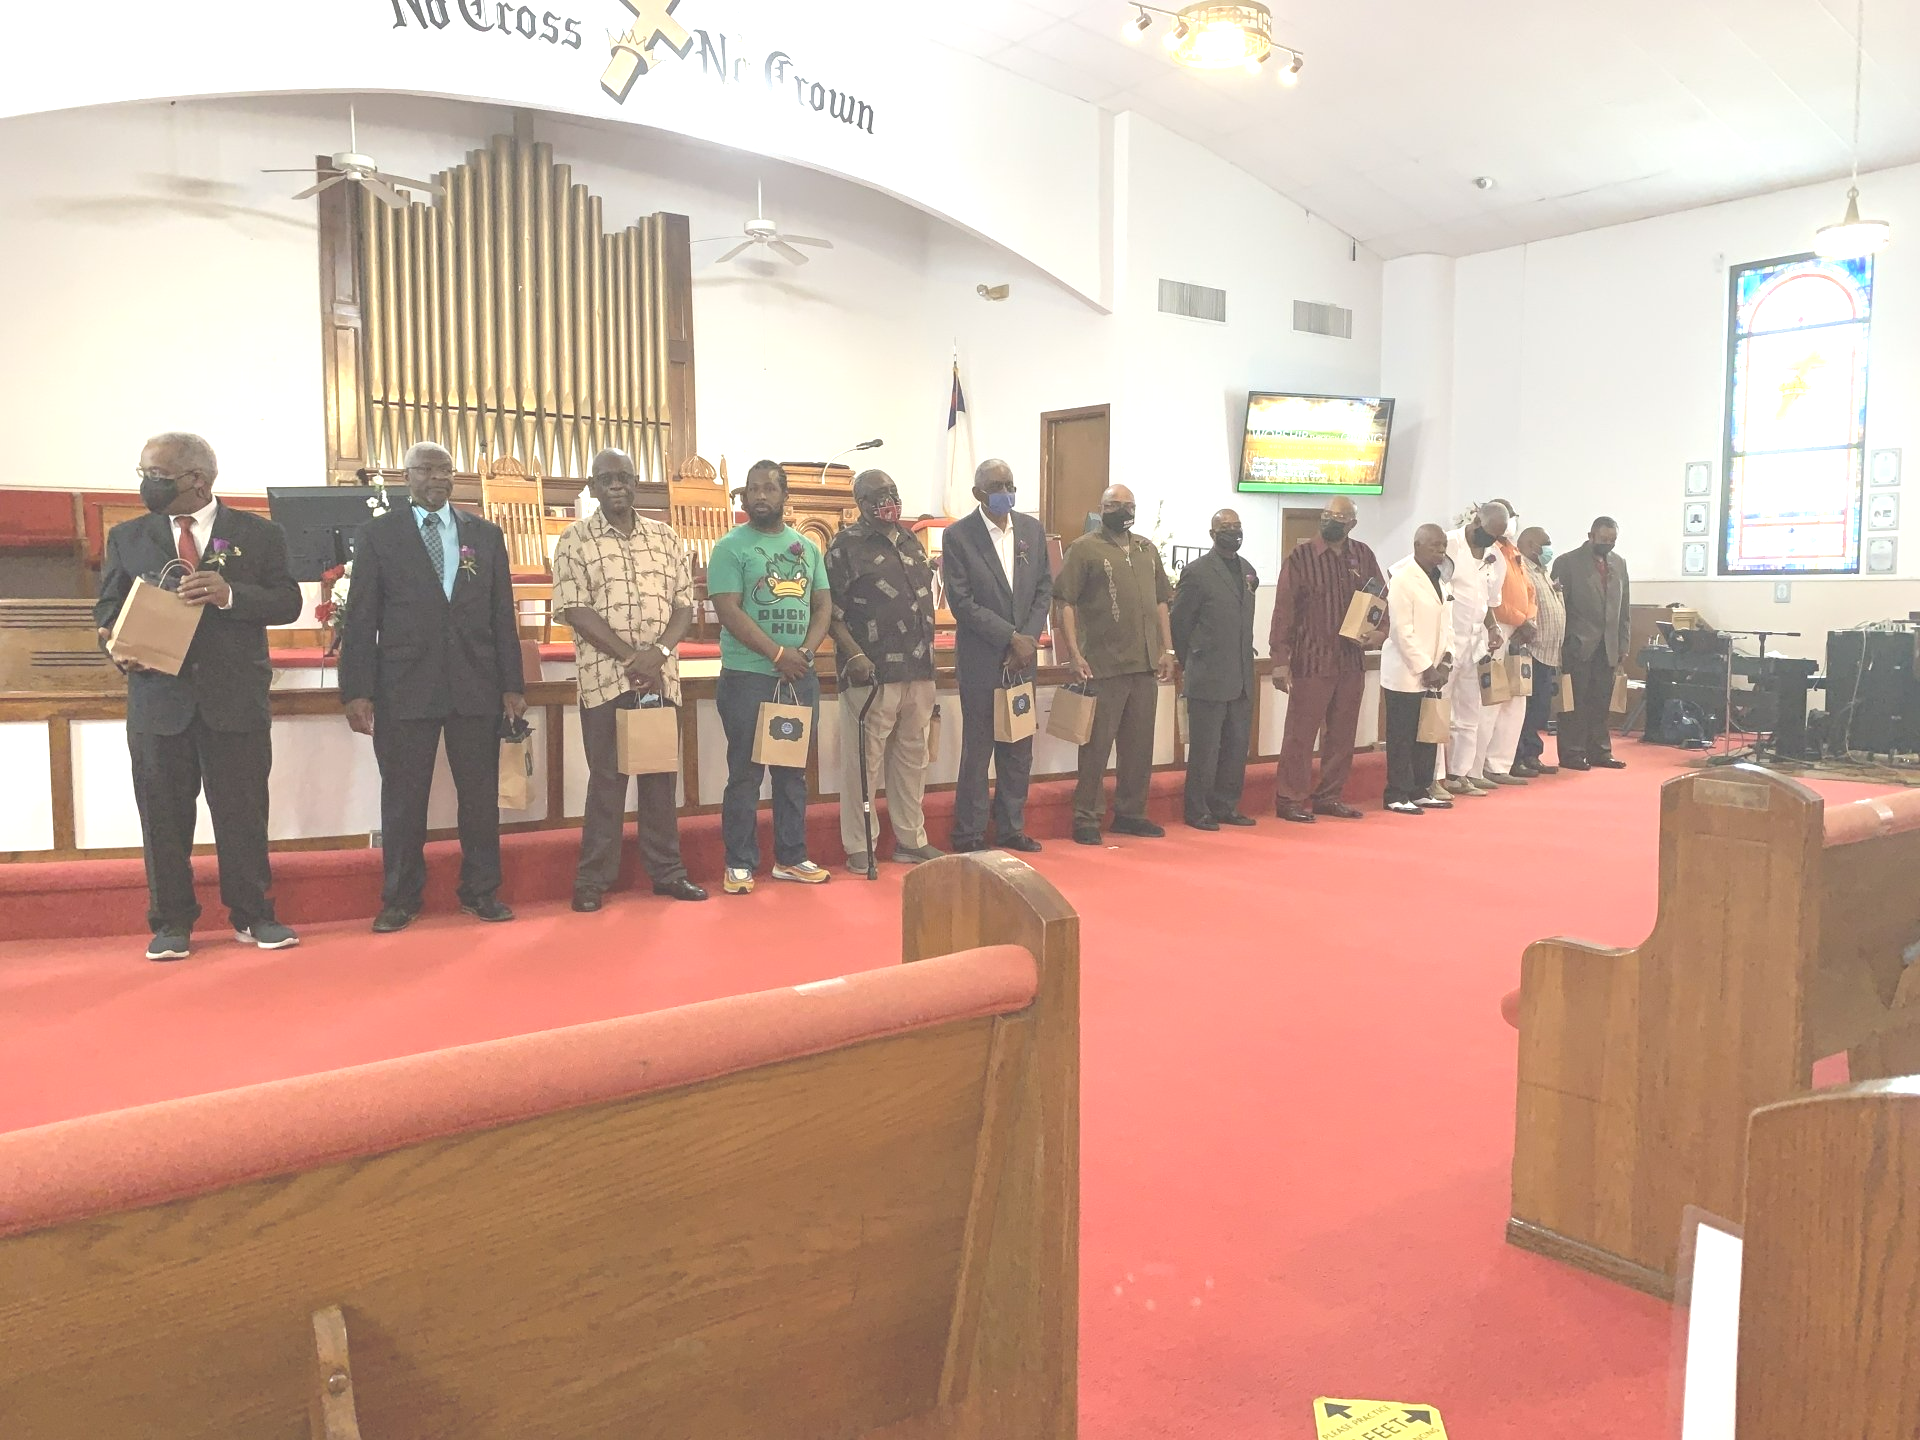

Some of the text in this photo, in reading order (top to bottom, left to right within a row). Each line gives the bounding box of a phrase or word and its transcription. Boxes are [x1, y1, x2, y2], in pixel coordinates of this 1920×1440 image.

[391, 0, 582, 50] No Cross
[764, 51, 874, 135] Crown
